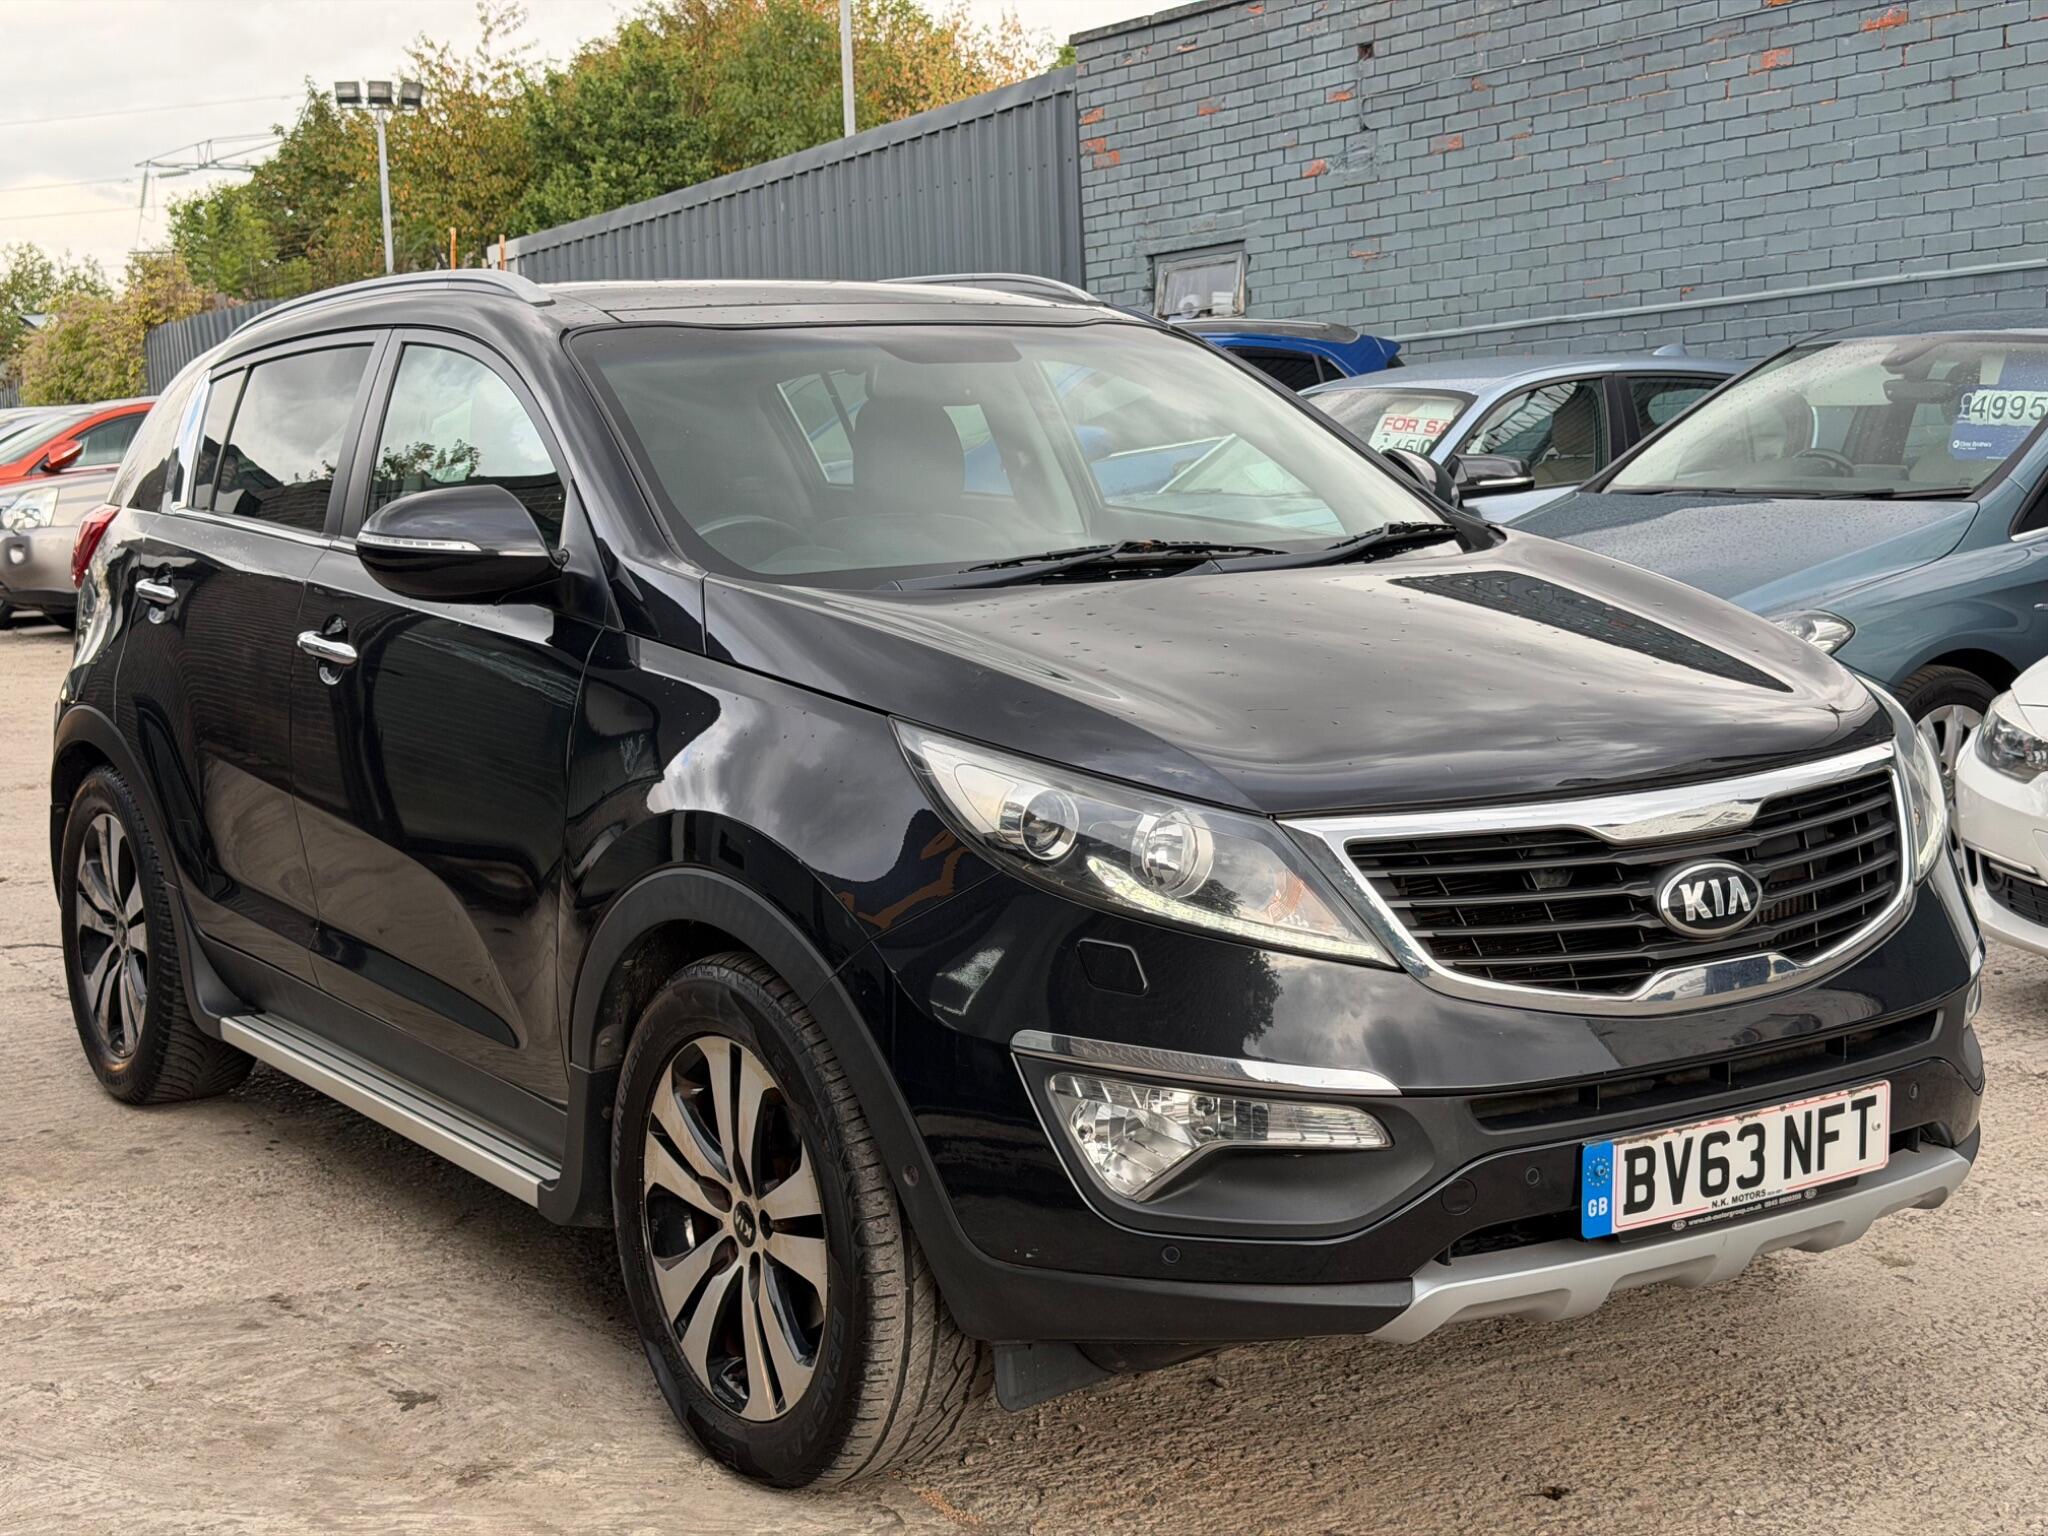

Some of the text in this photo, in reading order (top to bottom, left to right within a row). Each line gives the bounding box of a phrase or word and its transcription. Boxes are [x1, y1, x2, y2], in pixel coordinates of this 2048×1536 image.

[1381, 416, 1419, 433] FOR
[1679, 876, 1751, 921] KIA
[1623, 1094, 1877, 1216] BV63 NFT
[1588, 1196, 1608, 1217] GB
[1711, 1197, 1729, 1208] N.K.
[1731, 1189, 1766, 1204] MOTORS
